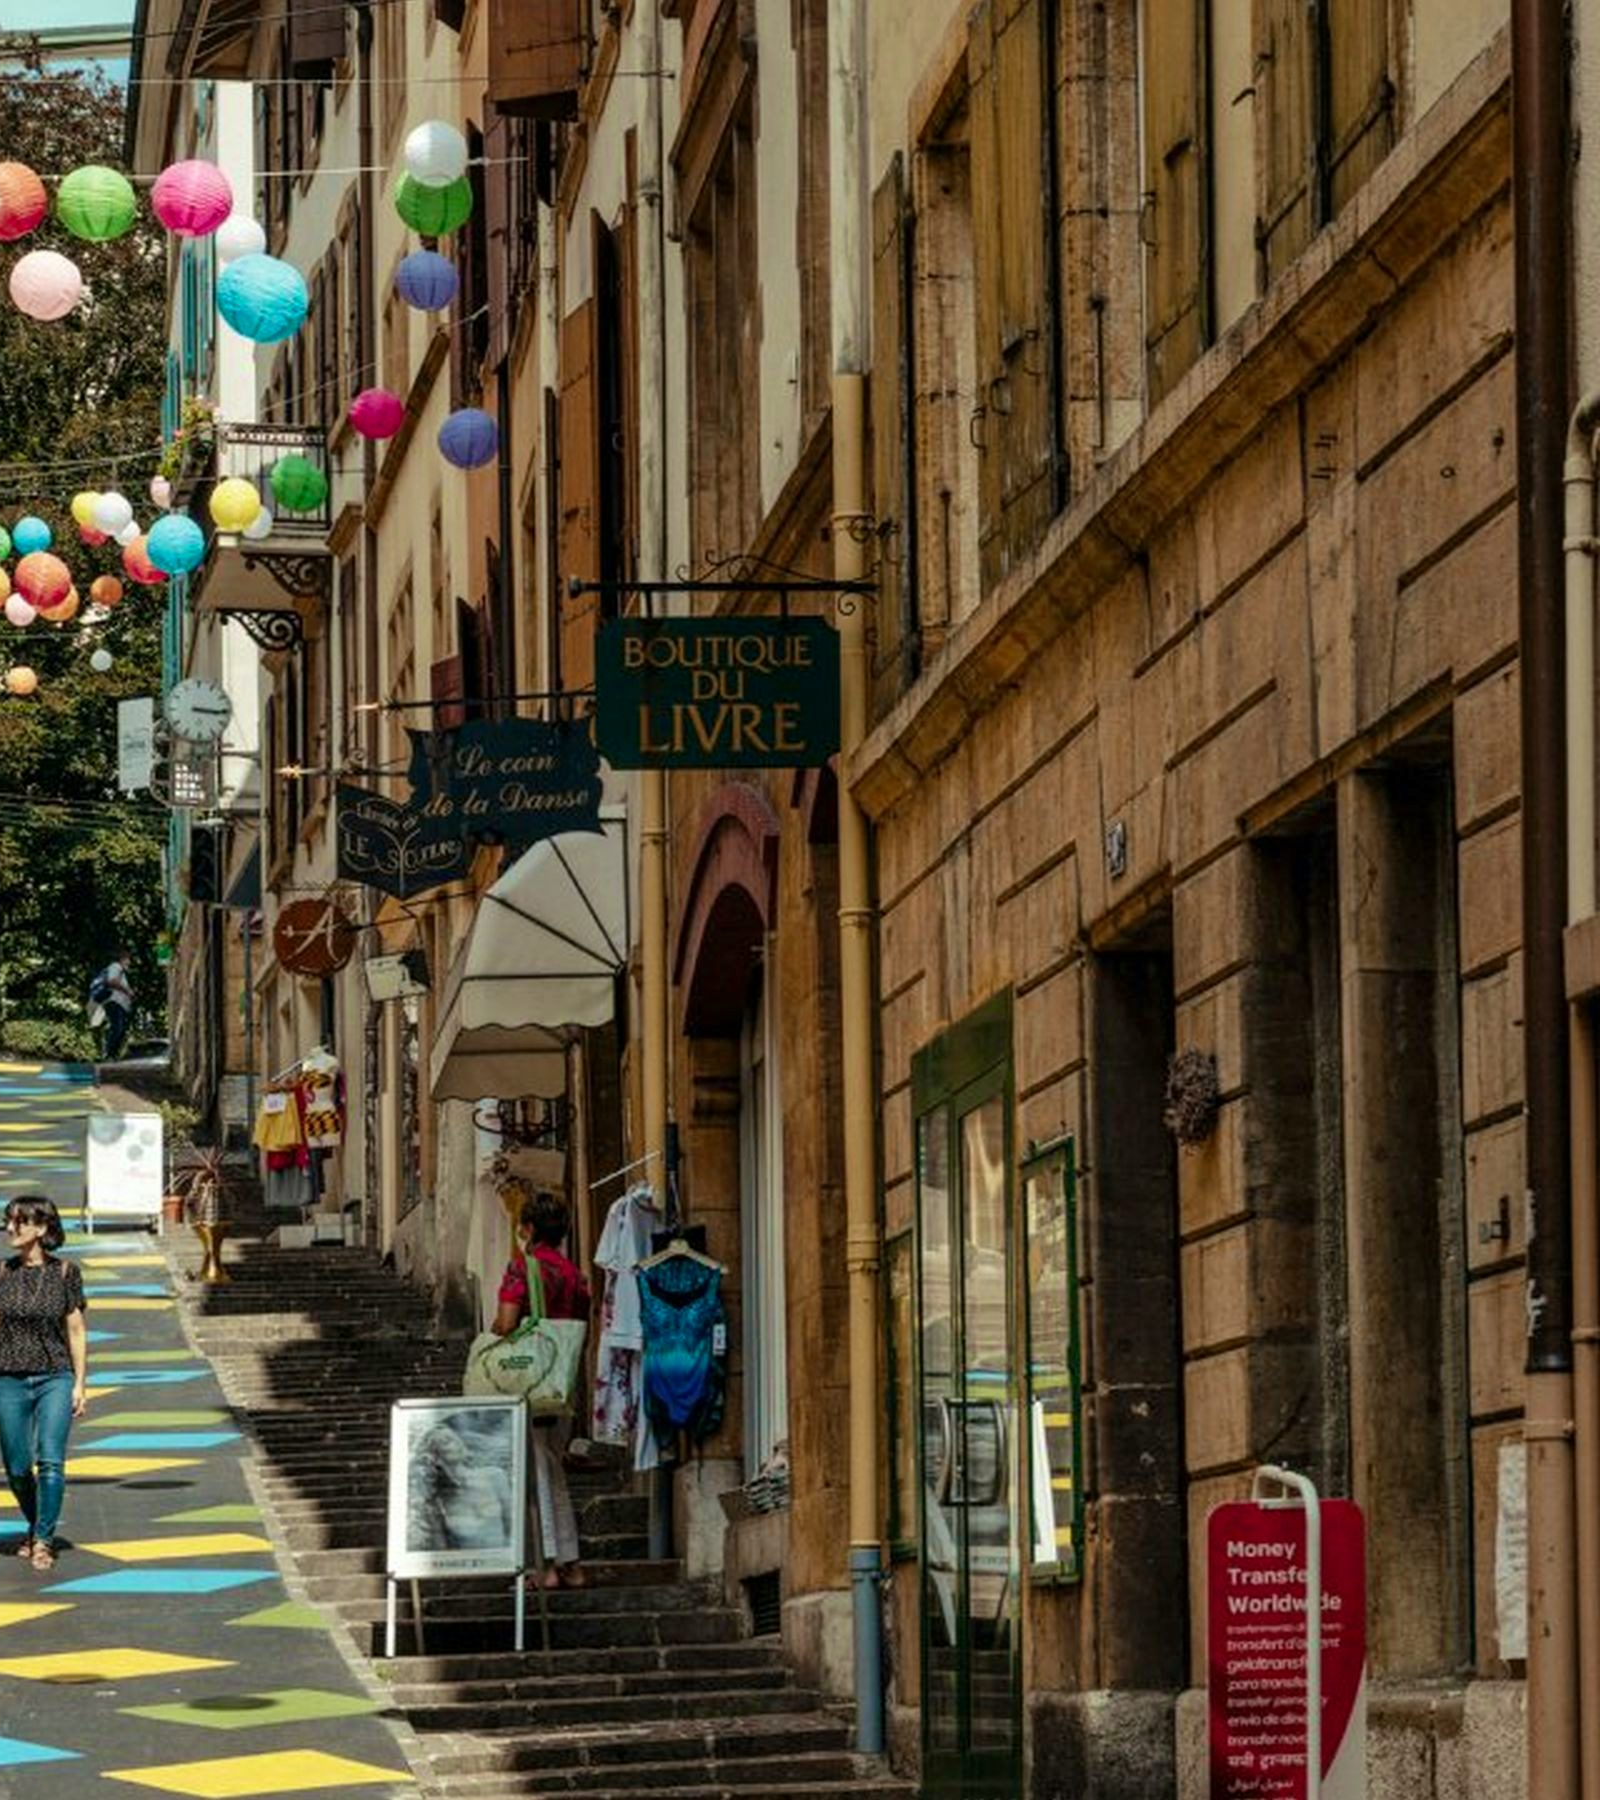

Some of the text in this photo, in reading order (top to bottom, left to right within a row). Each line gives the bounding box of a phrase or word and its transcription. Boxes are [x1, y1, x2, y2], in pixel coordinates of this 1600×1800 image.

[623, 635, 813, 674] BOUTIQUE
[692, 670, 745, 700] DU
[638, 702, 806, 753] LIVRE
[455, 745, 556, 778] Le coin
[422, 781, 589, 817] de la Danse
[1226, 1541, 1297, 1560] Money
[1227, 1566, 1308, 1586] Transfe
[1227, 1592, 1342, 1614] Worldwde
